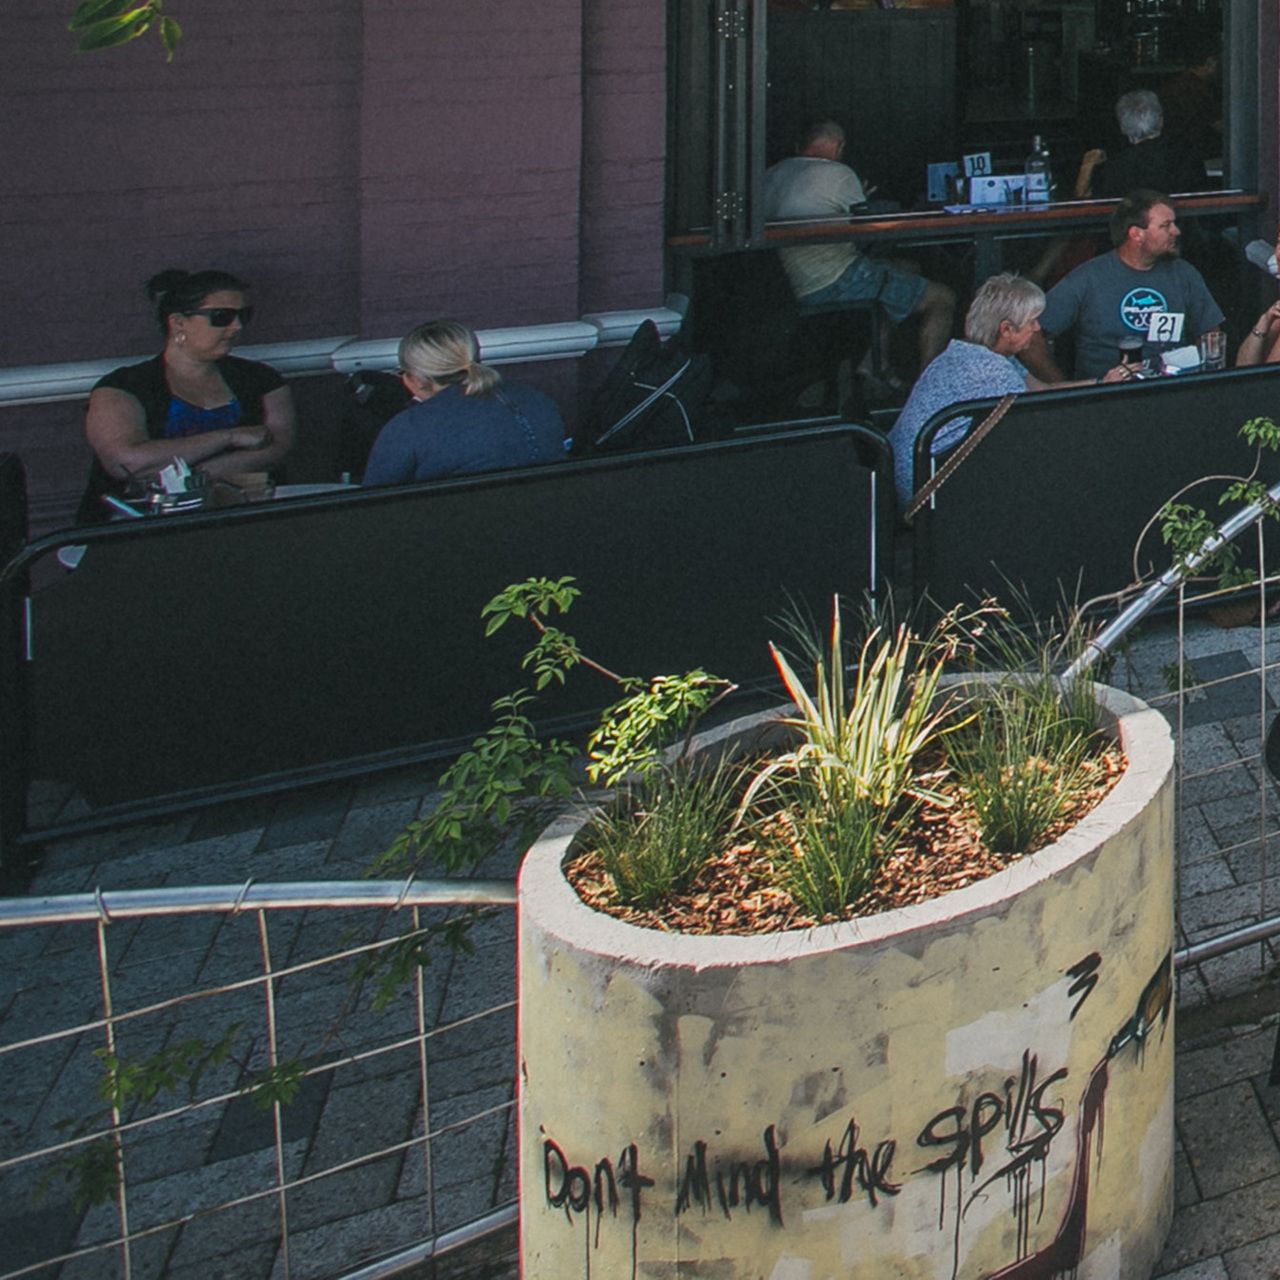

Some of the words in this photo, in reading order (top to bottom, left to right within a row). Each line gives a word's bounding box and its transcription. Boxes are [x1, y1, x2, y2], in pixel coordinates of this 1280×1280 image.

[969, 156, 986, 177] 10
[1157, 315, 1176, 336] 21
[815, 1118, 903, 1208] the
